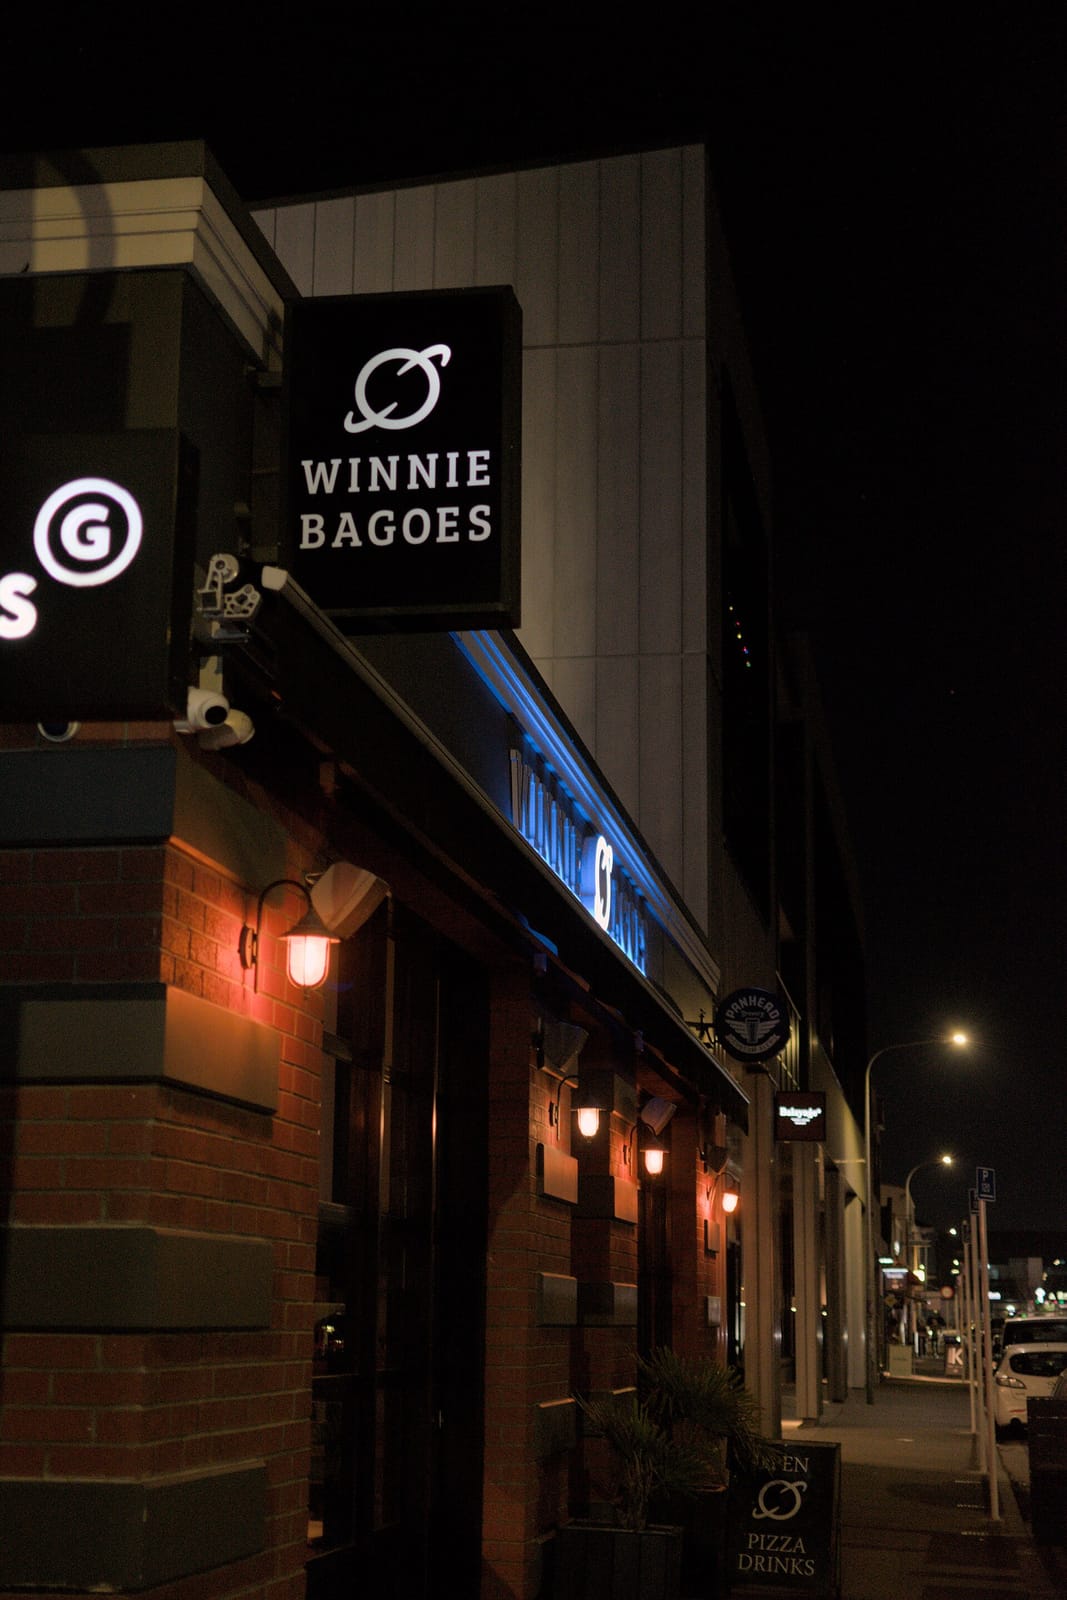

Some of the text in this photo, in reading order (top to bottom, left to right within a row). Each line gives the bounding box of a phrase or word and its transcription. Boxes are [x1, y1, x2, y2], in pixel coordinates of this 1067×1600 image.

[301, 449, 492, 496] WINNIE
[59, 502, 111, 563] G
[299, 503, 493, 551] BAGOES
[724, 994, 781, 1020] PANHEAD
[746, 1532, 807, 1554] PIZZA
[737, 1553, 816, 1577] DRINKS
